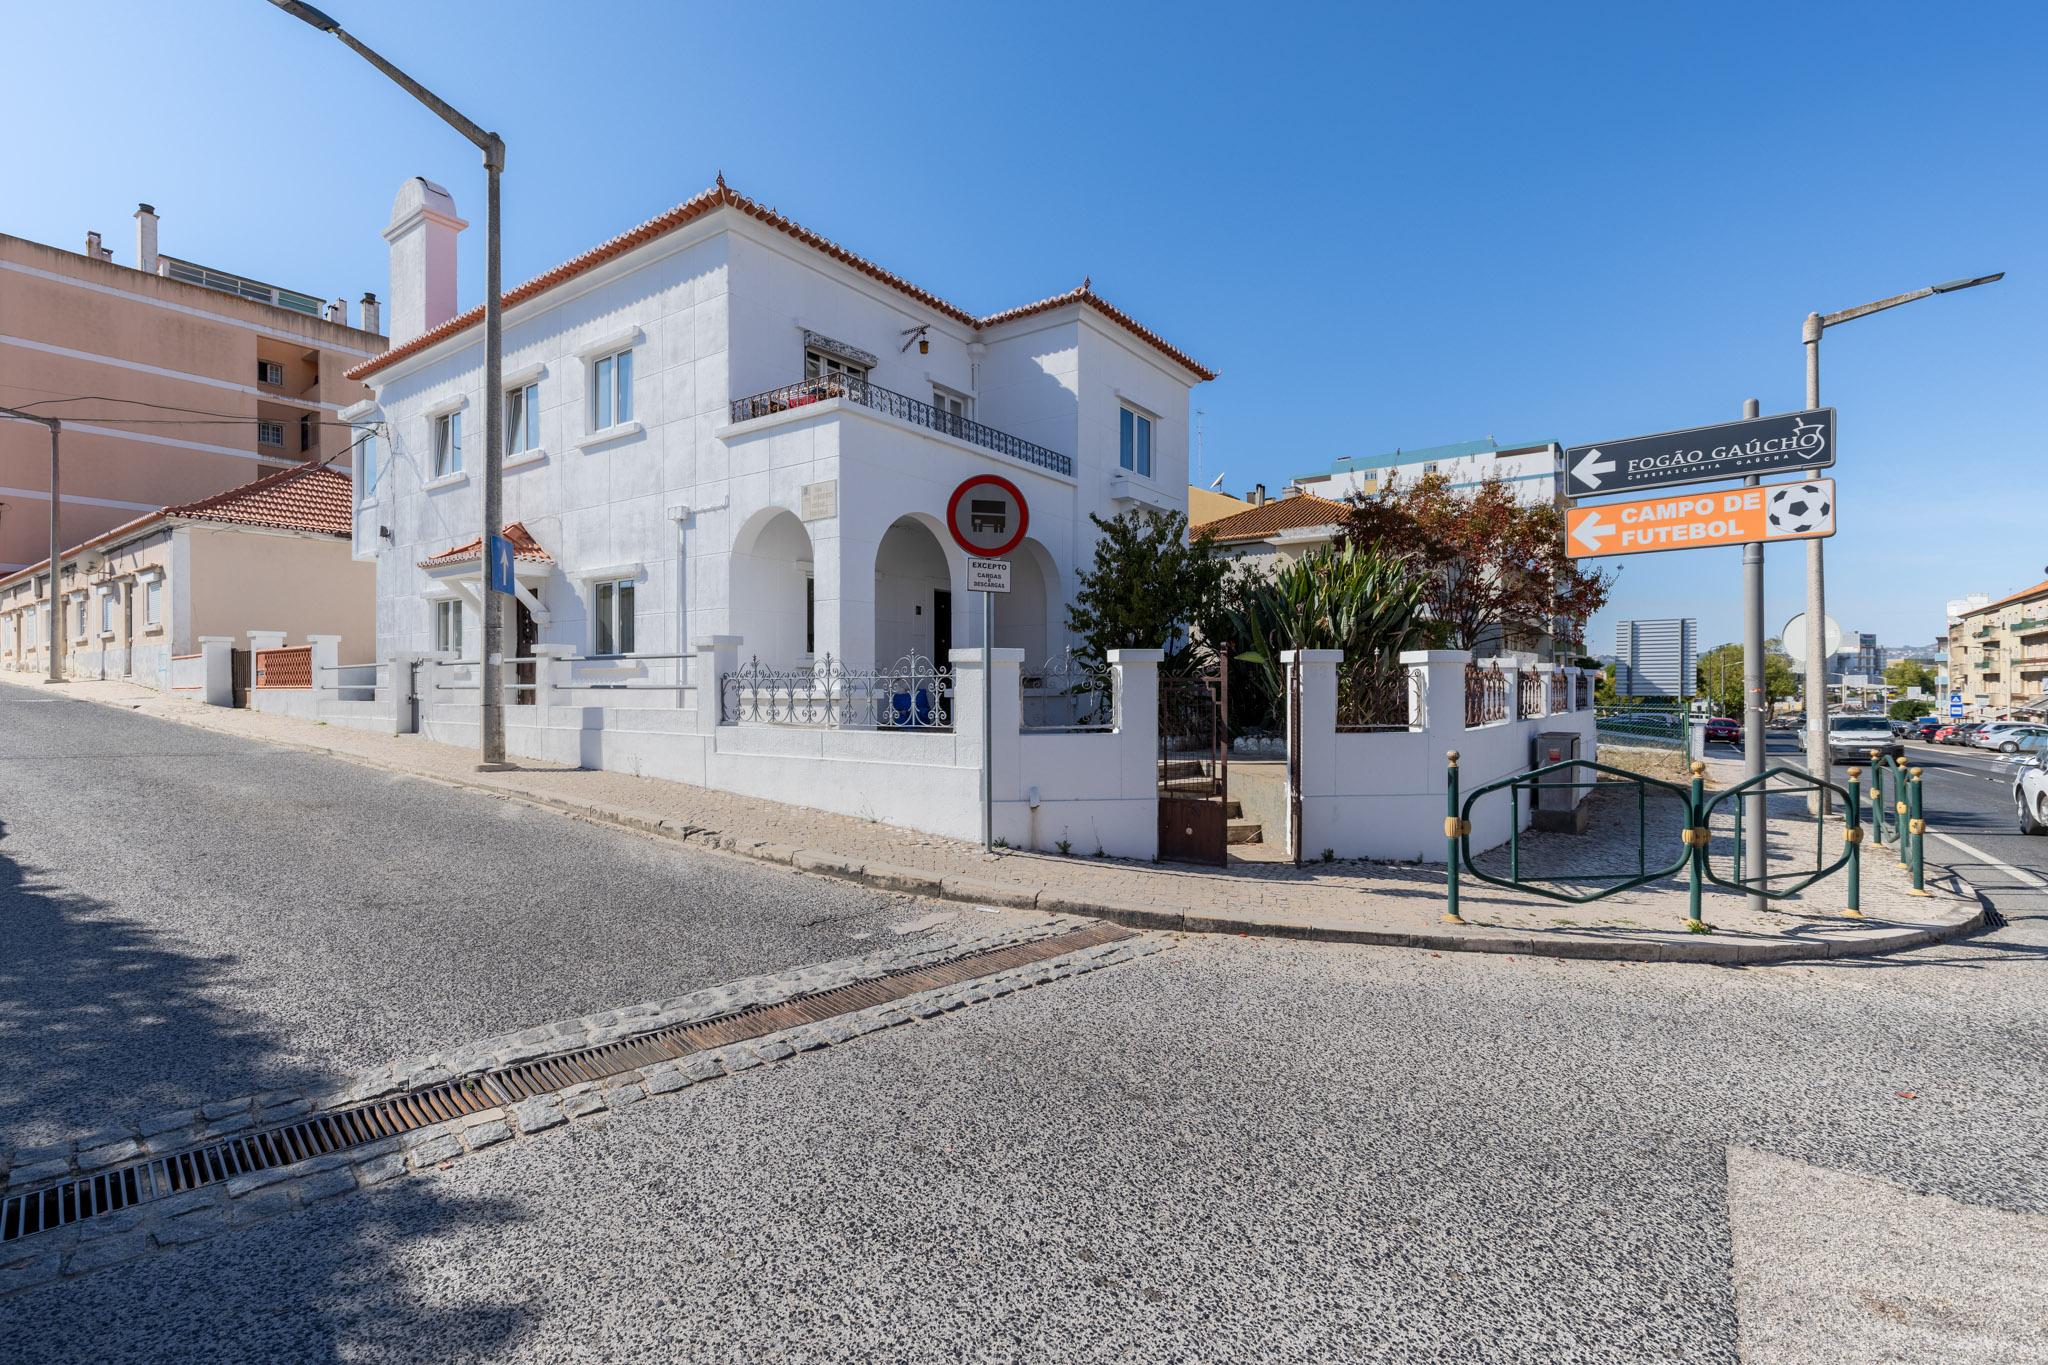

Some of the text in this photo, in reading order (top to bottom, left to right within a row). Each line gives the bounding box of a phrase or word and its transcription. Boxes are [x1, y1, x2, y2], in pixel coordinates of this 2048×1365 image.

[1627, 433, 1818, 472] FOGÃO GAÚCHO
[1627, 454, 1790, 480] CHURRASCARIA GAÚCHA
[1621, 492, 1761, 524] CAMPO DE
[1621, 519, 1745, 547] FUTEBOL
[972, 562, 1007, 570] EXCEPTO
